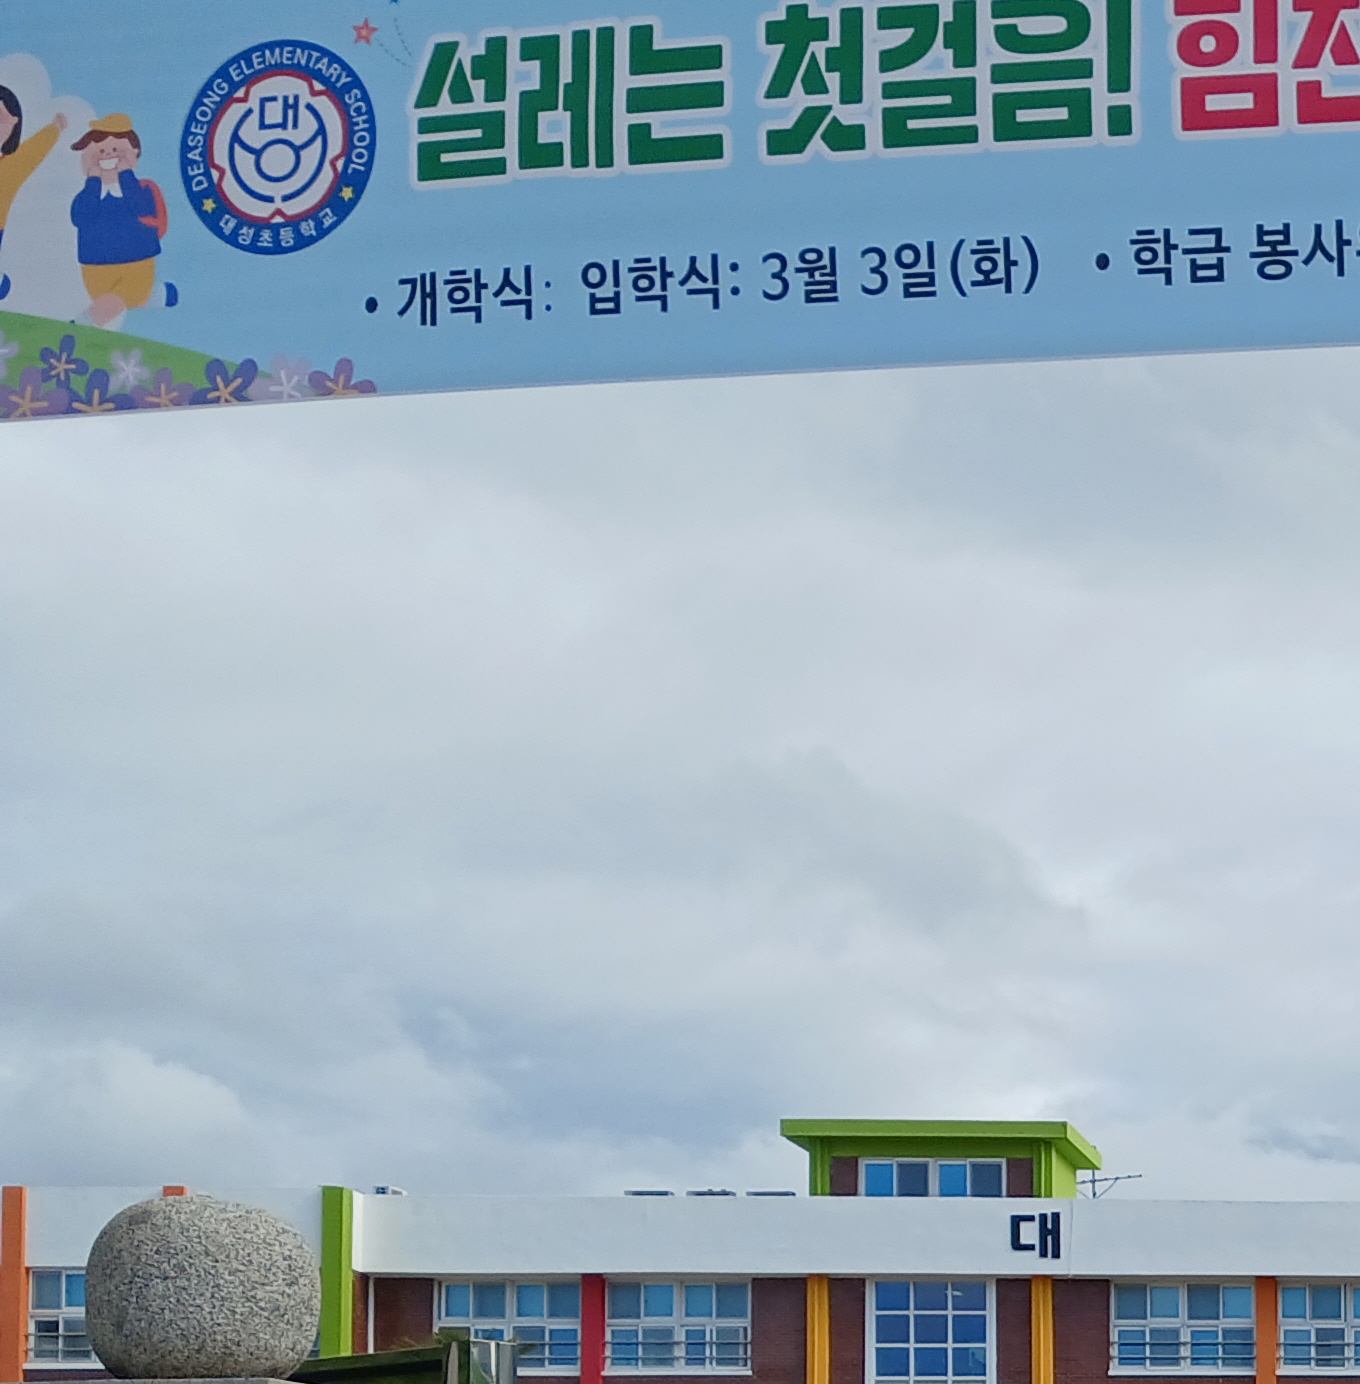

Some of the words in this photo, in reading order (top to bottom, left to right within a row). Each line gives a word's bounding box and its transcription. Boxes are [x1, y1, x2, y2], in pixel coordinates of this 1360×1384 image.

[187, 78, 229, 191] DEASEONG
[229, 46, 353, 89] ELEMENTARY
[344, 88, 370, 174] SCHOOL
[258, 93, 300, 131] 대
[413, 23, 726, 183] 설레는
[763, 0, 1133, 156] 첫걸음!
[219, 207, 338, 247] 대성초등학교
[397, 263, 553, 328] 개학식:
[580, 252, 740, 319] 입학식:
[760, 246, 839, 306] 3월
[859, 233, 1042, 302] 3일(화)
[1128, 224, 1232, 289] 학급
[1010, 1211, 1061, 1260] 대
